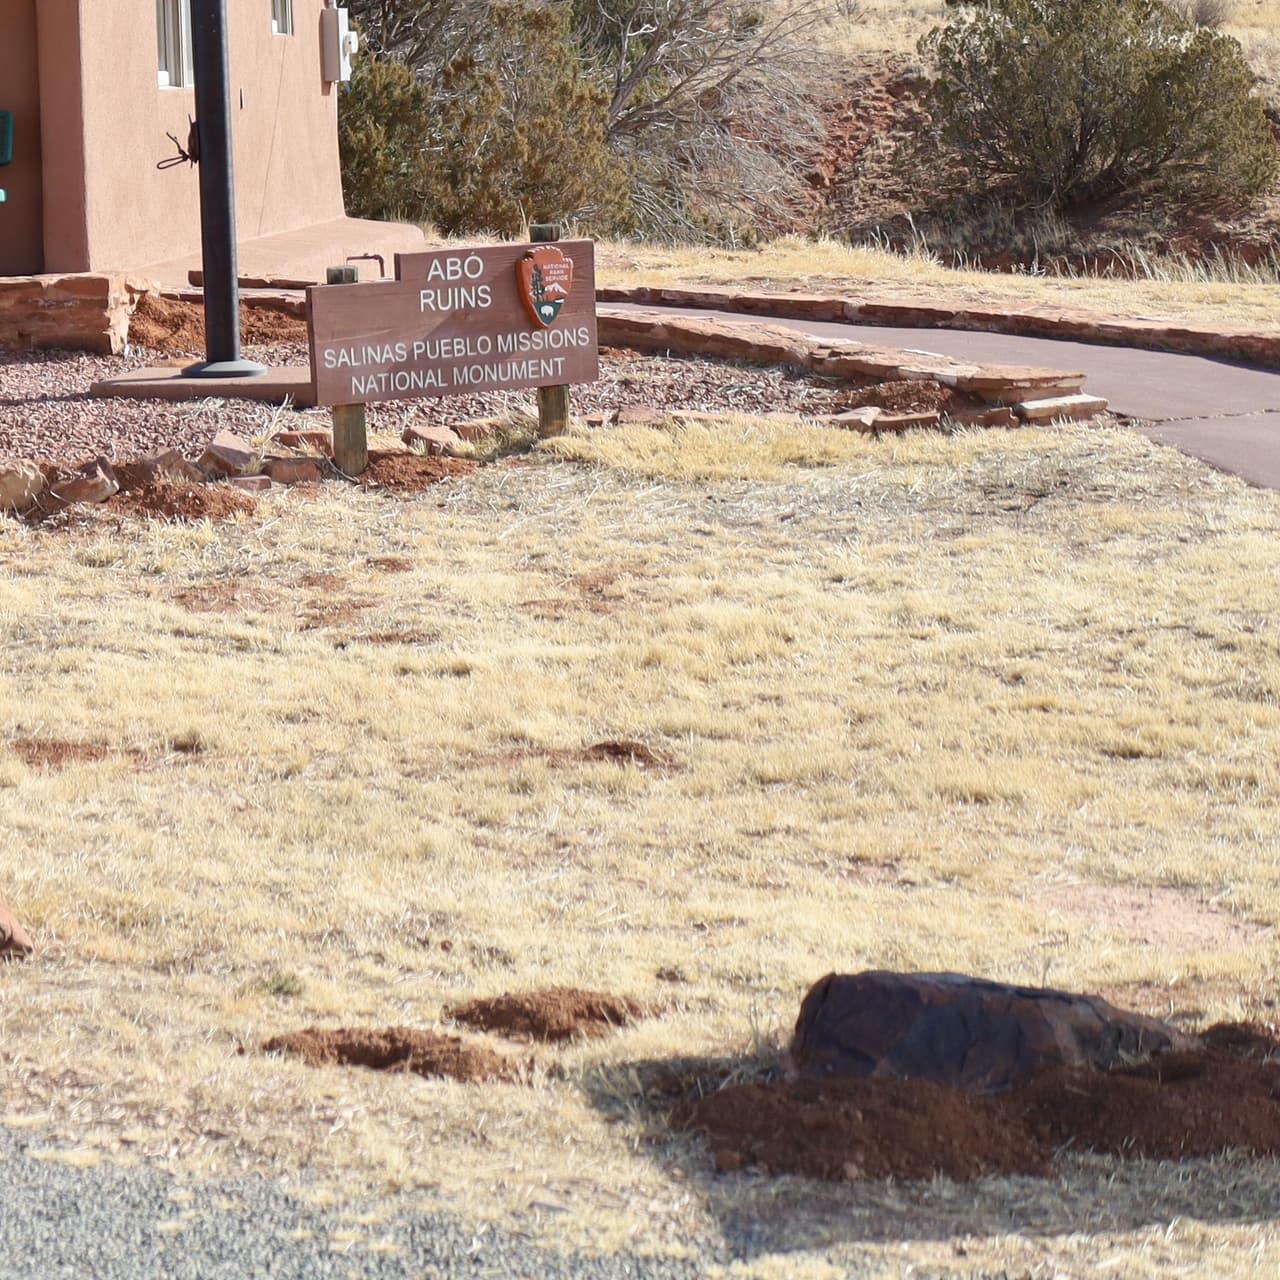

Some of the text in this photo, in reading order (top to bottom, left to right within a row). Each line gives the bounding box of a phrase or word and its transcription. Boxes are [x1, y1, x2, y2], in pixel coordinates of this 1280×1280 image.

[427, 251, 484, 282] ABÓ
[420, 285, 492, 312] RUINS
[324, 327, 589, 368] SALINAS PUEBLO MISSIONS
[351, 357, 565, 396] NATIONAL MONUMENT
